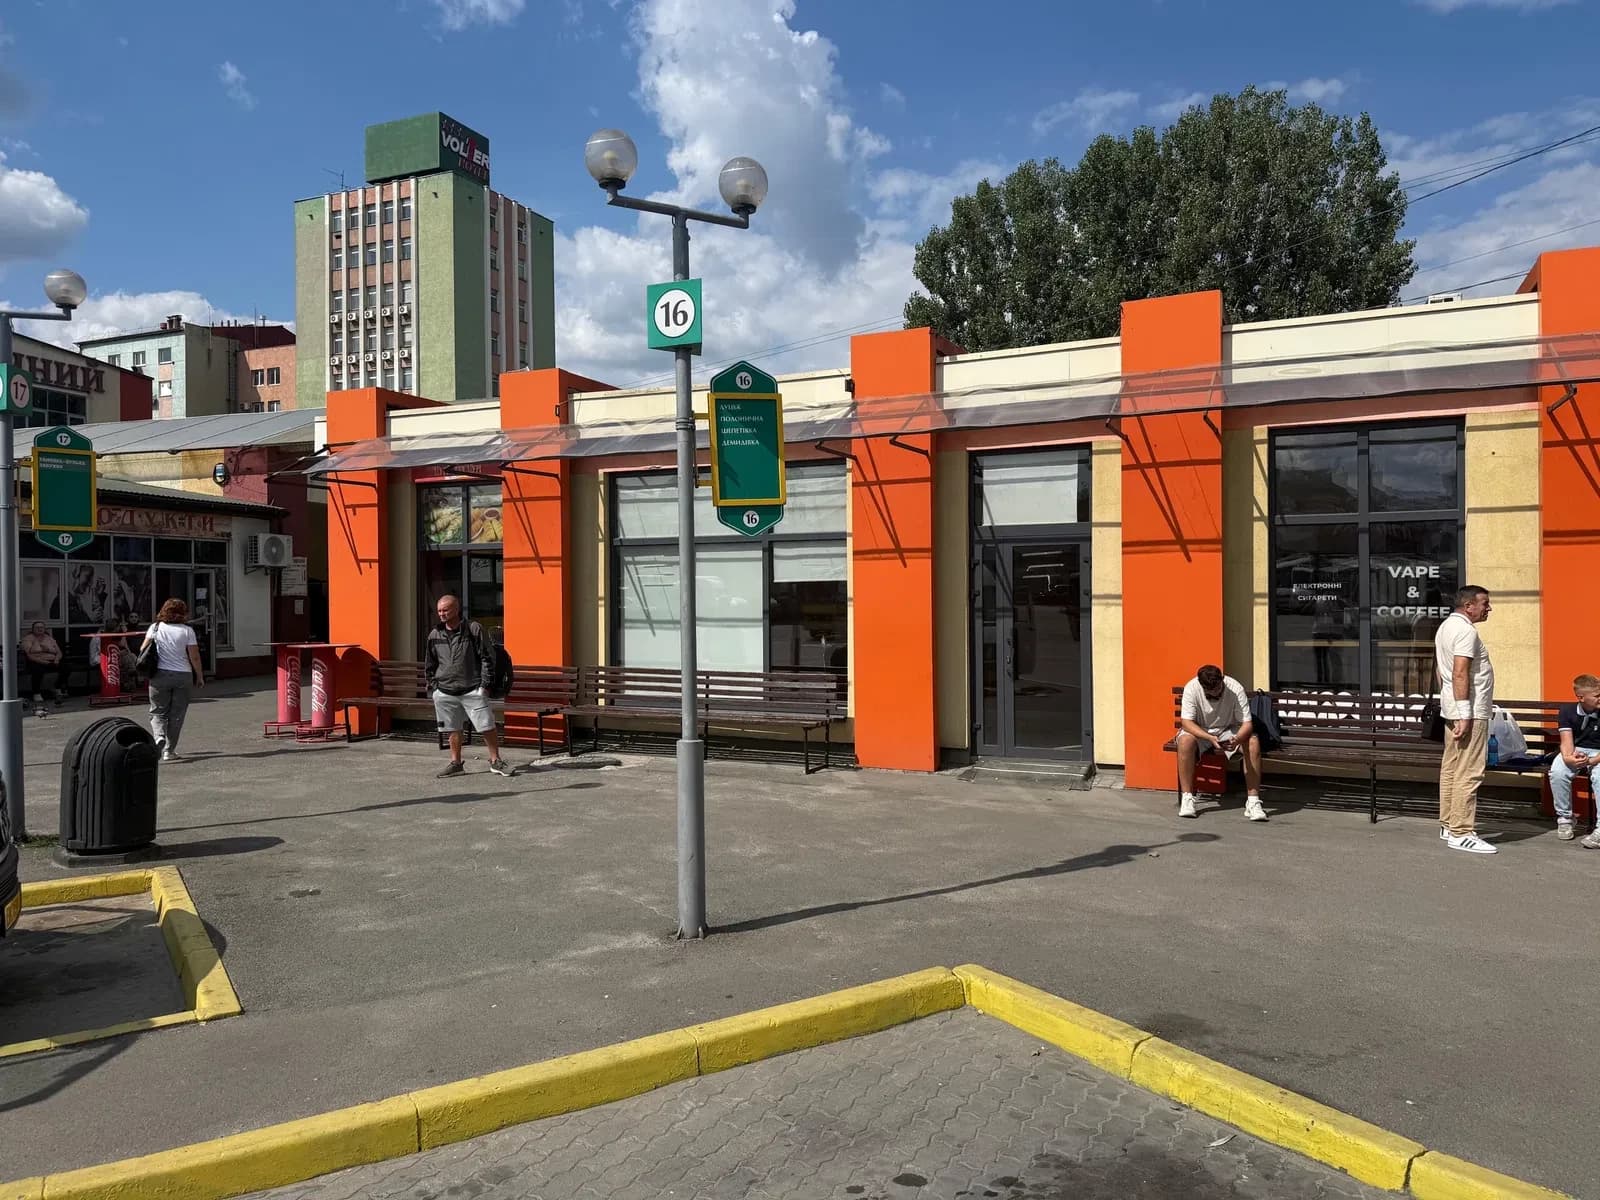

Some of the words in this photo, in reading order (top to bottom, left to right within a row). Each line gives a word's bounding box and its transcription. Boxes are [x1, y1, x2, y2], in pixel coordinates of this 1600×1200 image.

[660, 299, 689, 328] 16
[738, 375, 750, 386] 16
[13, 381, 28, 401] 17
[59, 434, 70, 444] 17
[96, 507, 215, 532] ОДУКТИ
[746, 513, 758, 524] 16
[61, 535, 71, 545] 17
[1387, 565, 1441, 579] VAPE
[1406, 585, 1420, 599] &
[1376, 605, 1451, 619] COFFEE
